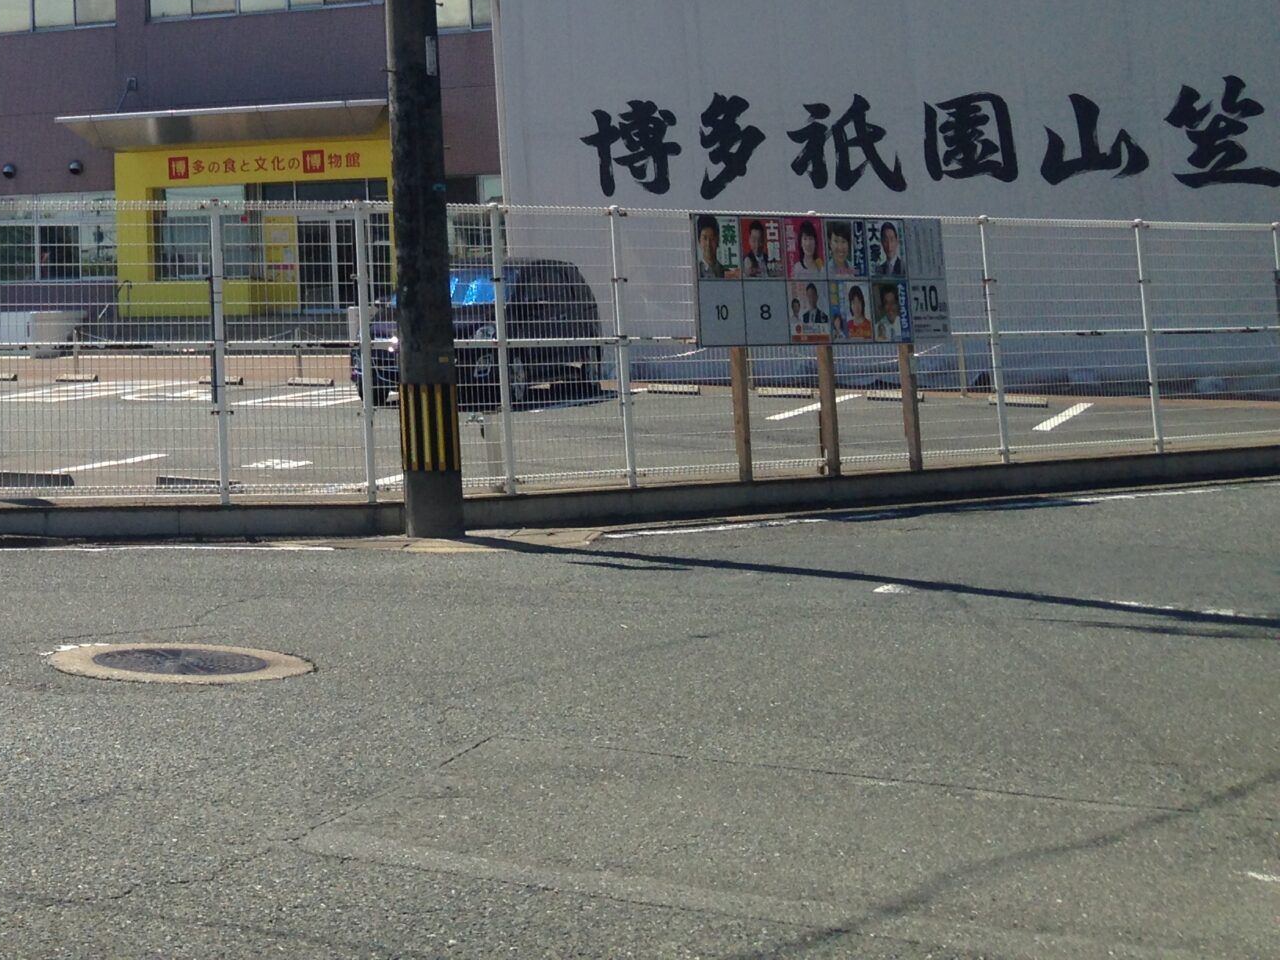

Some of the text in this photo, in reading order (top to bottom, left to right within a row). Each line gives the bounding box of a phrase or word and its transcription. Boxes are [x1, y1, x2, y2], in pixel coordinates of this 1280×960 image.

[580, 75, 1280, 200] 博多祇園山笠
[168, 149, 361, 180] 博多の食と文化の博物館
[715, 304, 729, 321] 10
[759, 303, 772, 320] 8
